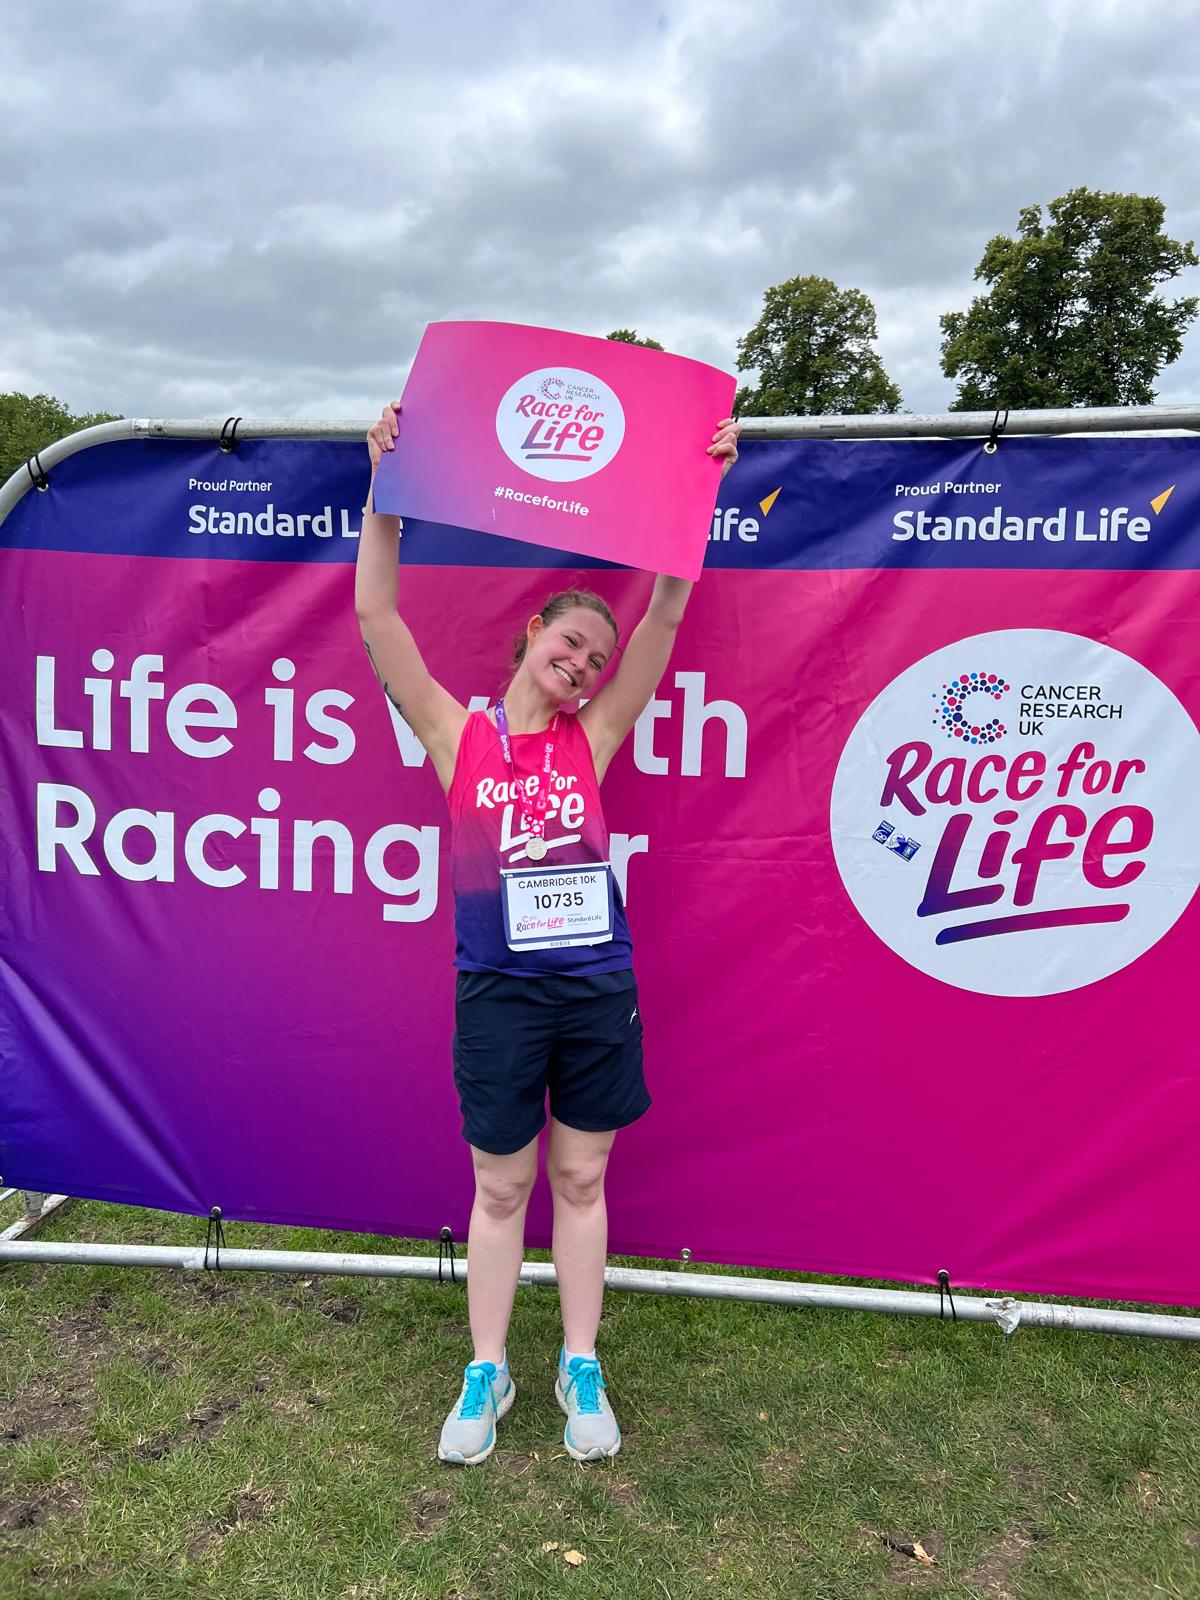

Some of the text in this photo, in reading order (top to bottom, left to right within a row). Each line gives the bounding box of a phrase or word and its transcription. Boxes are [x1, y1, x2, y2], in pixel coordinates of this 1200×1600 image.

[565, 389, 600, 401] RESEARCH
[567, 383, 594, 394] CANCER
[515, 394, 604, 422] Race for
[520, 419, 605, 451] Life
[188, 478, 273, 492] Proud Partner
[894, 481, 1002, 497] Proud Partner
[494, 485, 590, 518] #RaceforLife
[188, 503, 333, 538] Standard
[708, 507, 760, 542] ife
[892, 506, 1151, 542] Standard Life
[36, 648, 238, 759] Life
[265, 657, 355, 765] is
[1019, 684, 1102, 702] CANCER
[1018, 703, 1123, 720] RESEARCH
[1018, 721, 1044, 737] UK
[476, 774, 540, 809] Race
[879, 741, 1146, 817] Race for
[36, 782, 440, 922] Racing
[916, 803, 1154, 918] Life
[518, 875, 597, 889] CAMBRIDGE 10K
[534, 891, 584, 910] 10735
[516, 921, 536, 933] Race
[547, 916, 565, 928] Life
